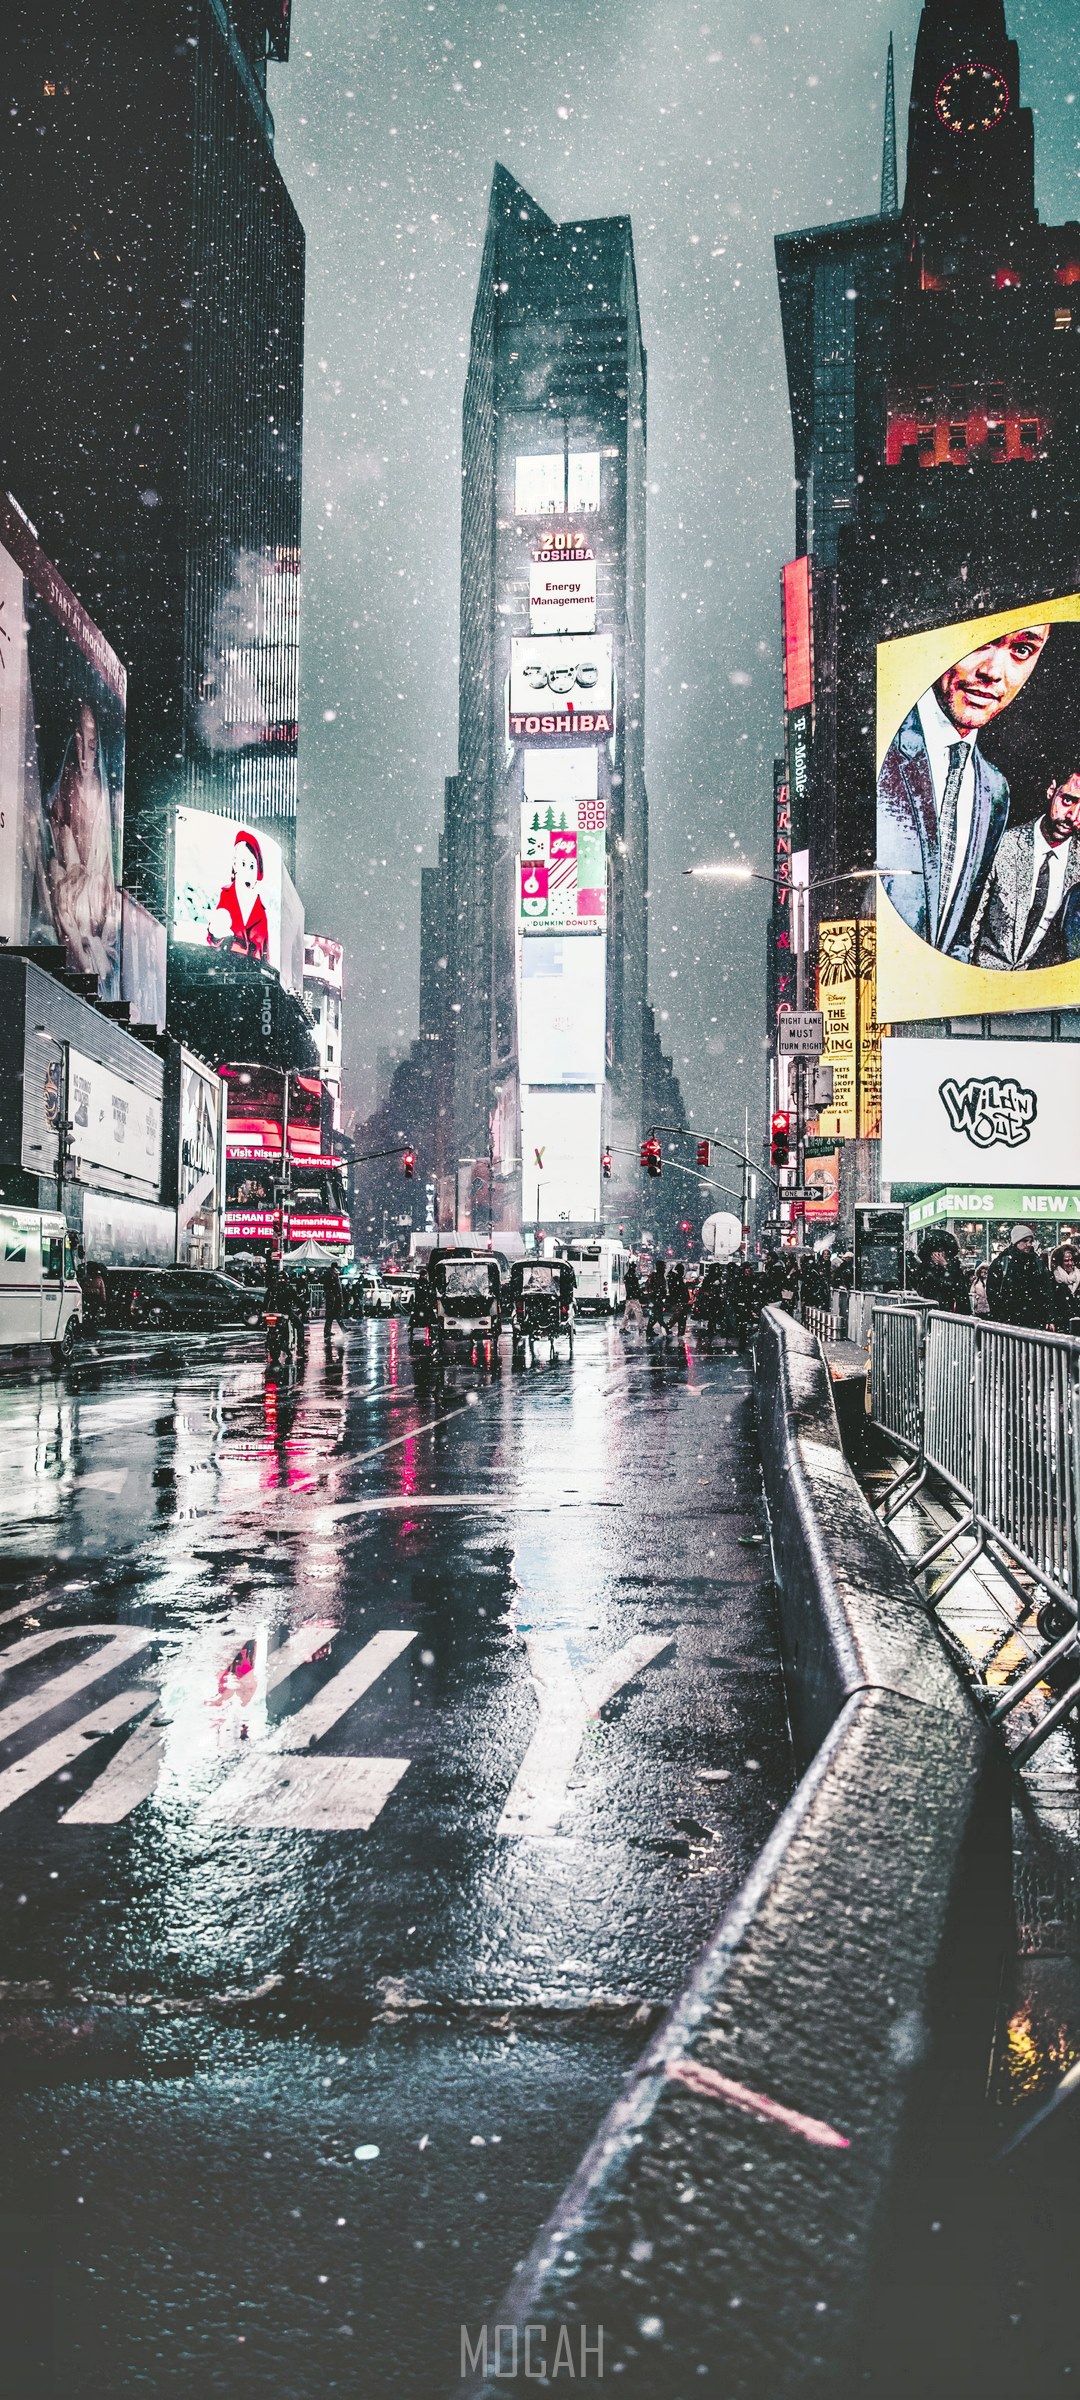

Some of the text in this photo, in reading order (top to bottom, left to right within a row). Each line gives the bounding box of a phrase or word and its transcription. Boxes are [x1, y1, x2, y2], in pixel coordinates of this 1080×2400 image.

[541, 533, 585, 549] 2017
[532, 549, 594, 561] TOSHIBA
[545, 583, 581, 593] Energy
[531, 595, 595, 606] Management
[511, 715, 610, 734] TOSHIBA
[551, 838, 577, 854] Joy
[827, 1009, 846, 1018] THE
[781, 1017, 822, 1025] RIGHT LANE
[825, 1021, 849, 1035] LION
[789, 1029, 813, 1038] MUST
[230, 1148, 252, 1158] Visit
[784, 1189, 817, 1197] ONE WAY
[1022, 1195, 1069, 1212] NEW
[242, 1227, 256, 1235] OF
[292, 1230, 325, 1239] NISSAN
